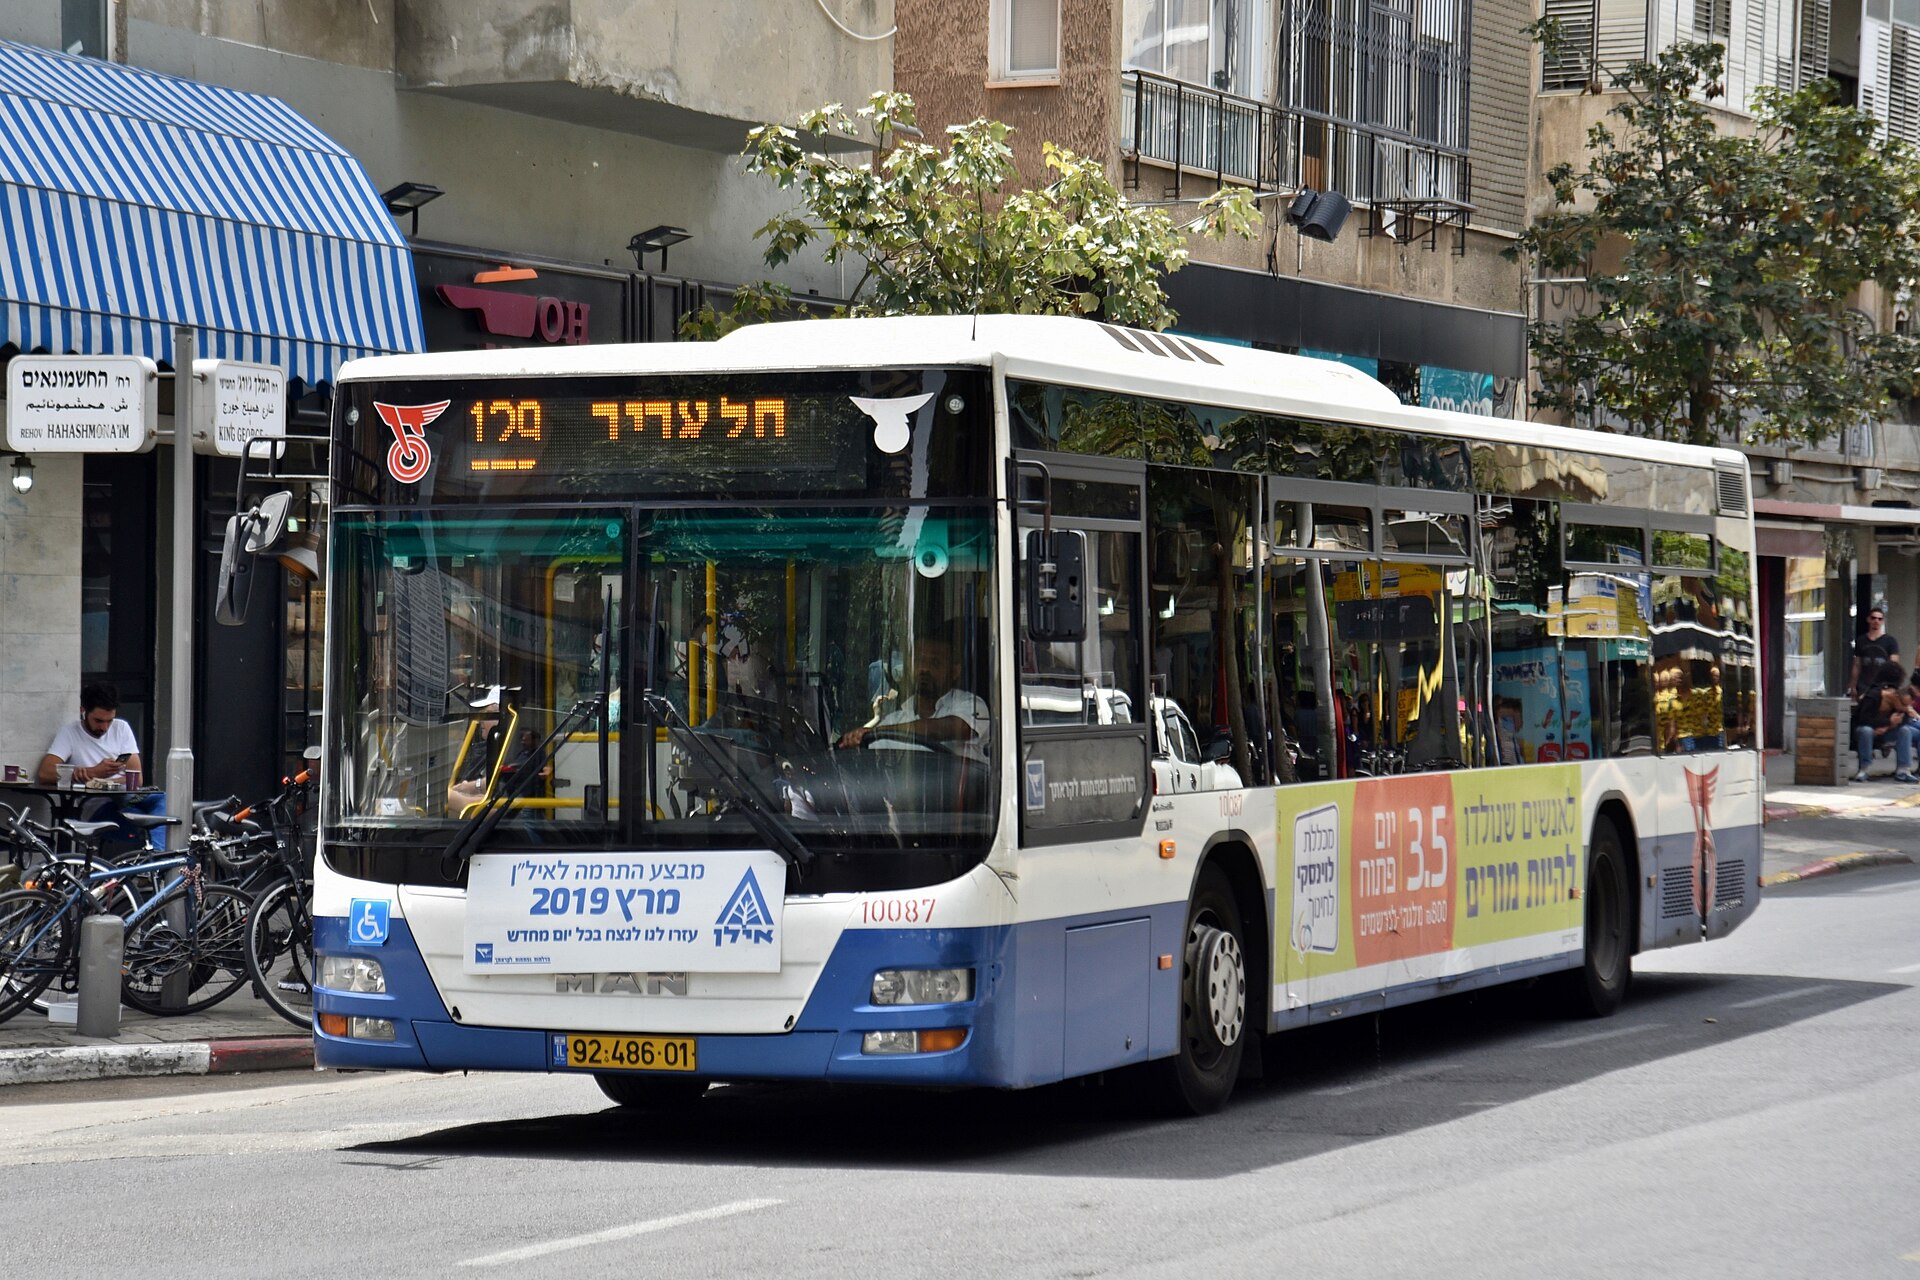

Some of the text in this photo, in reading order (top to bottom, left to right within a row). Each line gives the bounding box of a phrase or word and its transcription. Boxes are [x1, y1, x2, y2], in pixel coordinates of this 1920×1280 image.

[22, 370, 108, 388] החשמונאים
[20, 428, 43, 439] REHOV
[218, 425, 236, 442] KING
[1464, 788, 1576, 846] לאנשים שנולדו
[1303, 824, 1335, 852] מכללת
[1374, 811, 1397, 850] יום
[1406, 805, 1448, 892] 3.5
[575, 864, 644, 880] התרמה
[649, 864, 705, 882] מבצע
[1297, 856, 1335, 893] לוינסקי
[1359, 856, 1397, 898] פתוח
[1465, 843, 1577, 918] להיות מורים
[529, 887, 681, 923] מרץ 2019
[862, 899, 936, 924] 10087
[507, 926, 698, 943] עזרו לנו לנצח בכל יום מחדש
[713, 925, 774, 947] אילן
[554, 972, 689, 996] MAN
